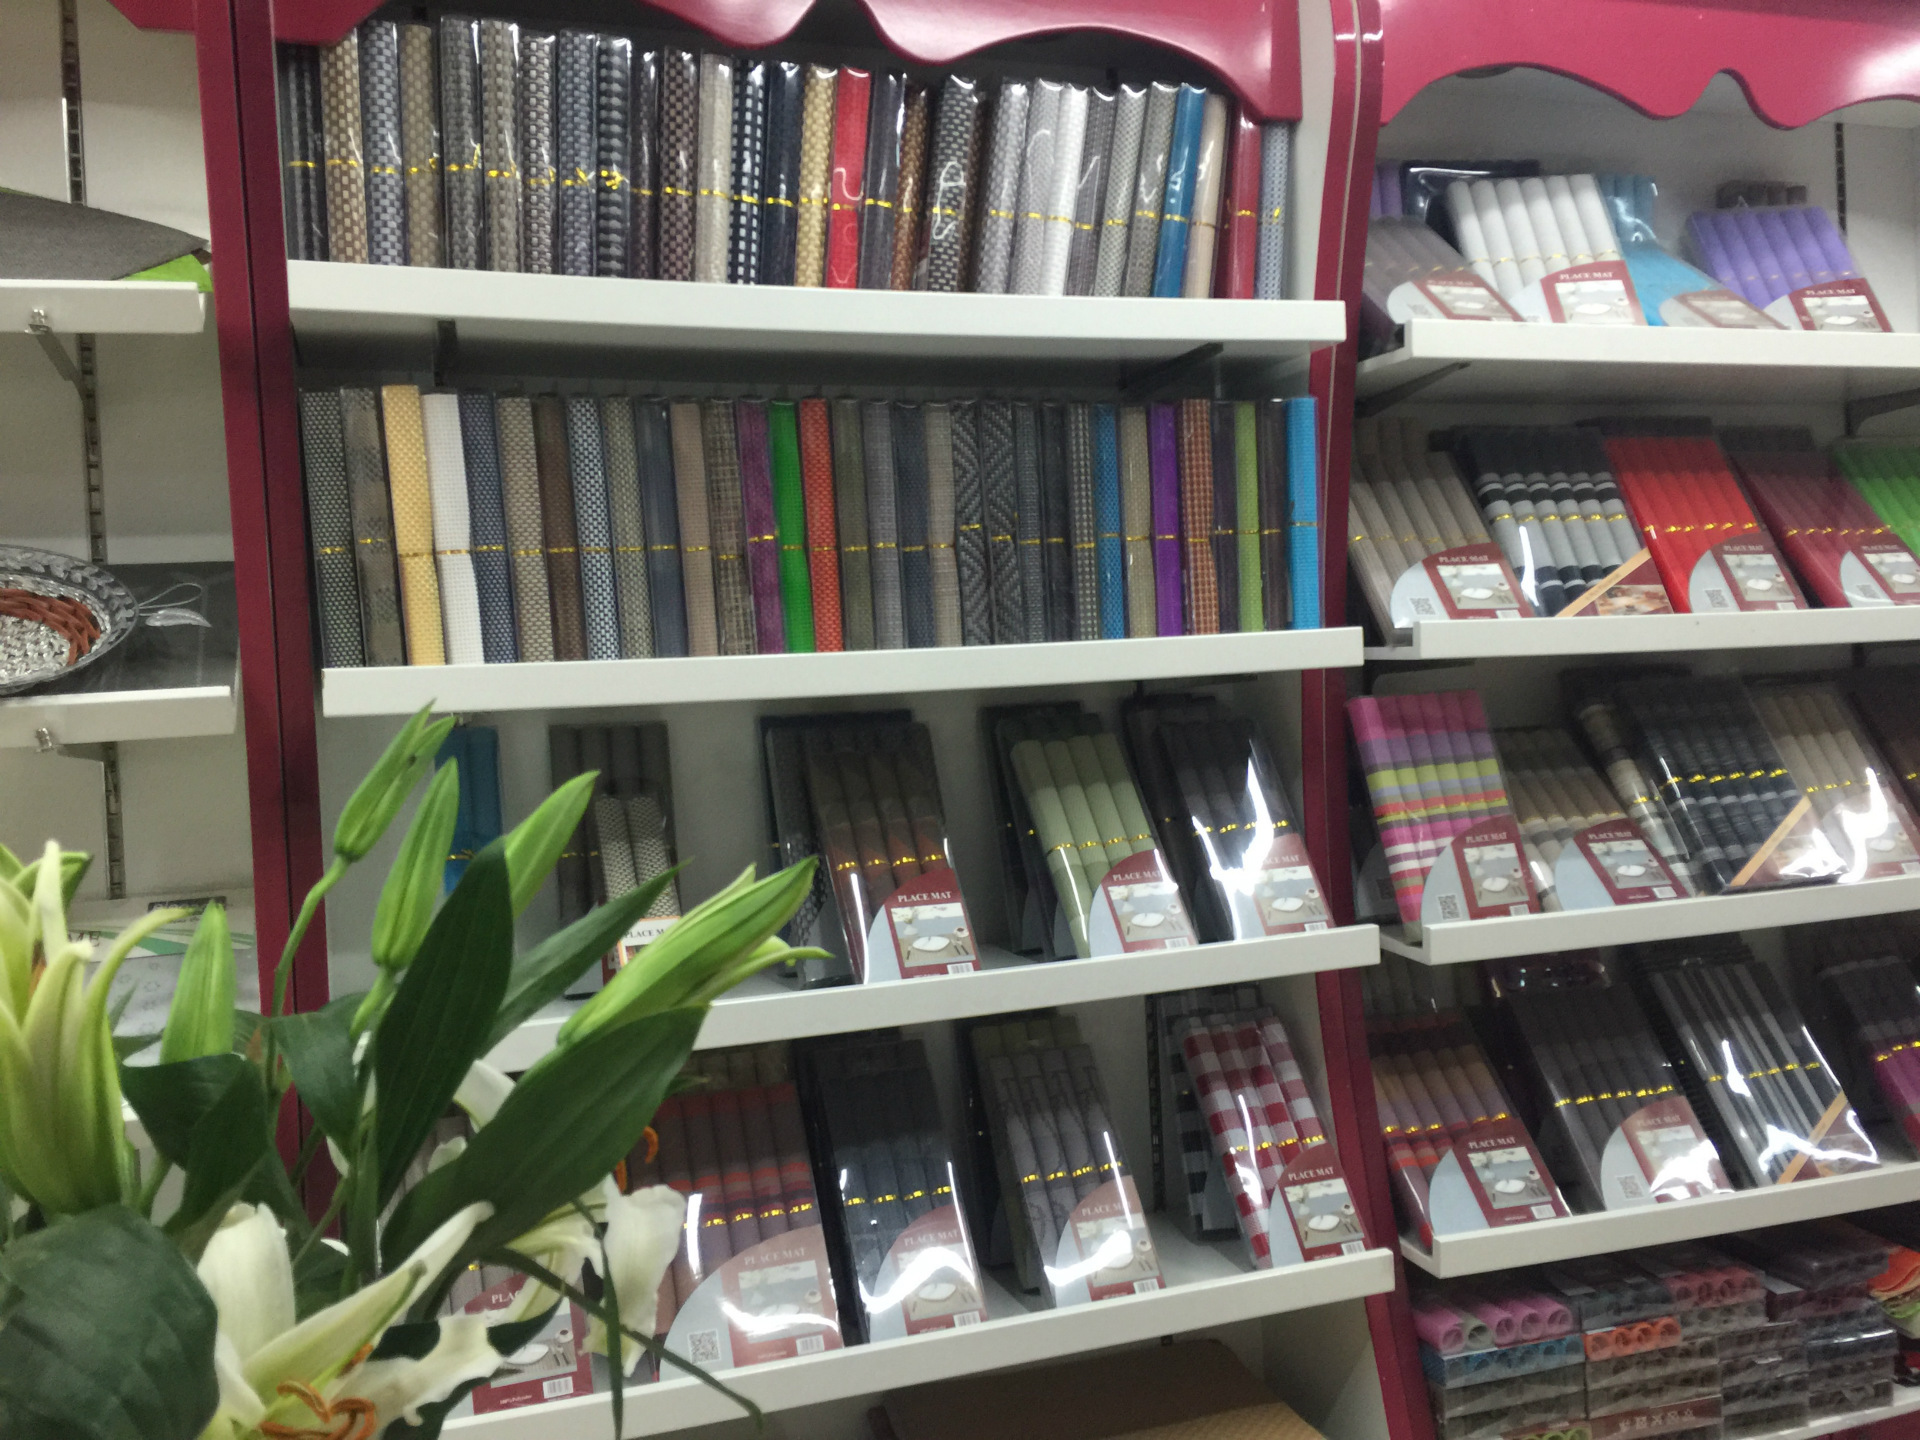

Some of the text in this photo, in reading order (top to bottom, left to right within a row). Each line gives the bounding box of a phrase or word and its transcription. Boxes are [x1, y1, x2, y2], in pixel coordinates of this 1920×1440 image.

[1560, 271, 1614, 280] PLACE MAT
[1466, 832, 1508, 843] PLACE MAT
[1588, 832, 1614, 840] PLACE
[1281, 854, 1300, 863] MAT
[1112, 872, 1141, 882] PLACE
[898, 891, 952, 903] PLACE MAT
[1468, 1136, 1516, 1150] PLACE MAT
[1288, 1166, 1335, 1182] PLACE MAT
[1081, 1204, 1110, 1217] PLACE
[904, 1229, 959, 1247] PLACE MAT
[744, 1248, 806, 1266] PLACE MAT
[491, 1291, 516, 1305] PLA
